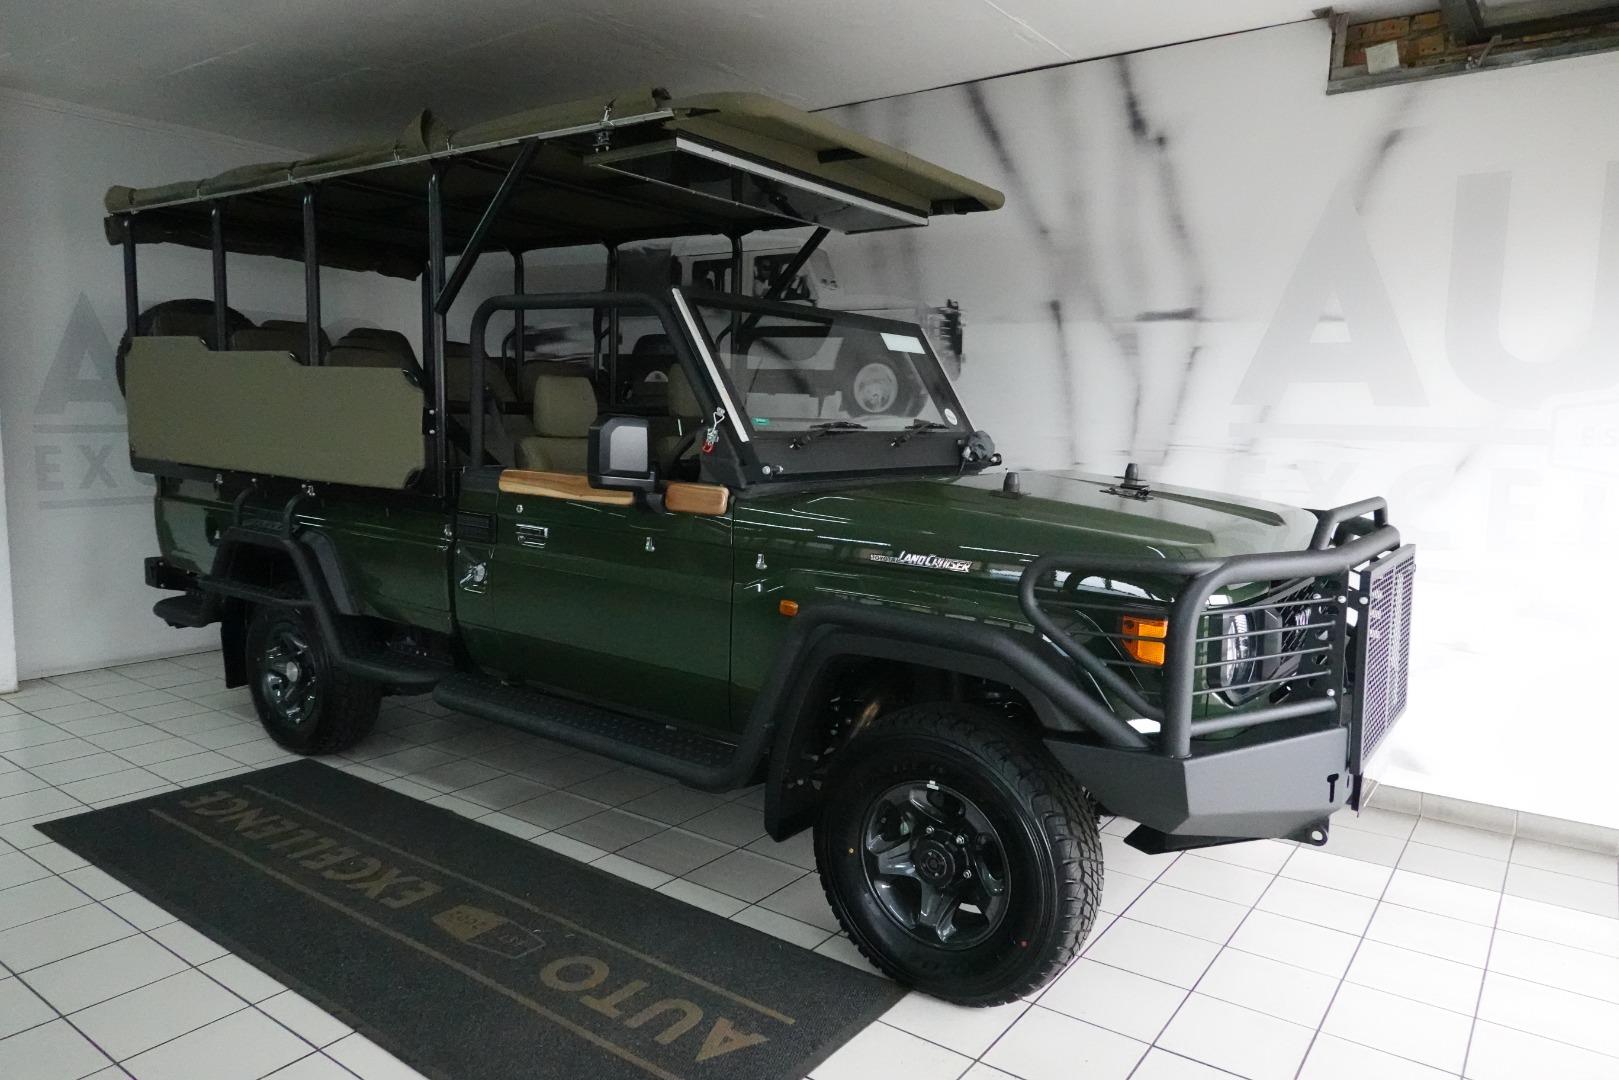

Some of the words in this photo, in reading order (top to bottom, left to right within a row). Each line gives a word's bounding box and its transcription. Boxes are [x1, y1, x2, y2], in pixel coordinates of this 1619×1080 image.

[34, 445, 156, 491] EX
[179, 789, 444, 911] EXCELLENCE
[538, 956, 770, 1063] AUTO
